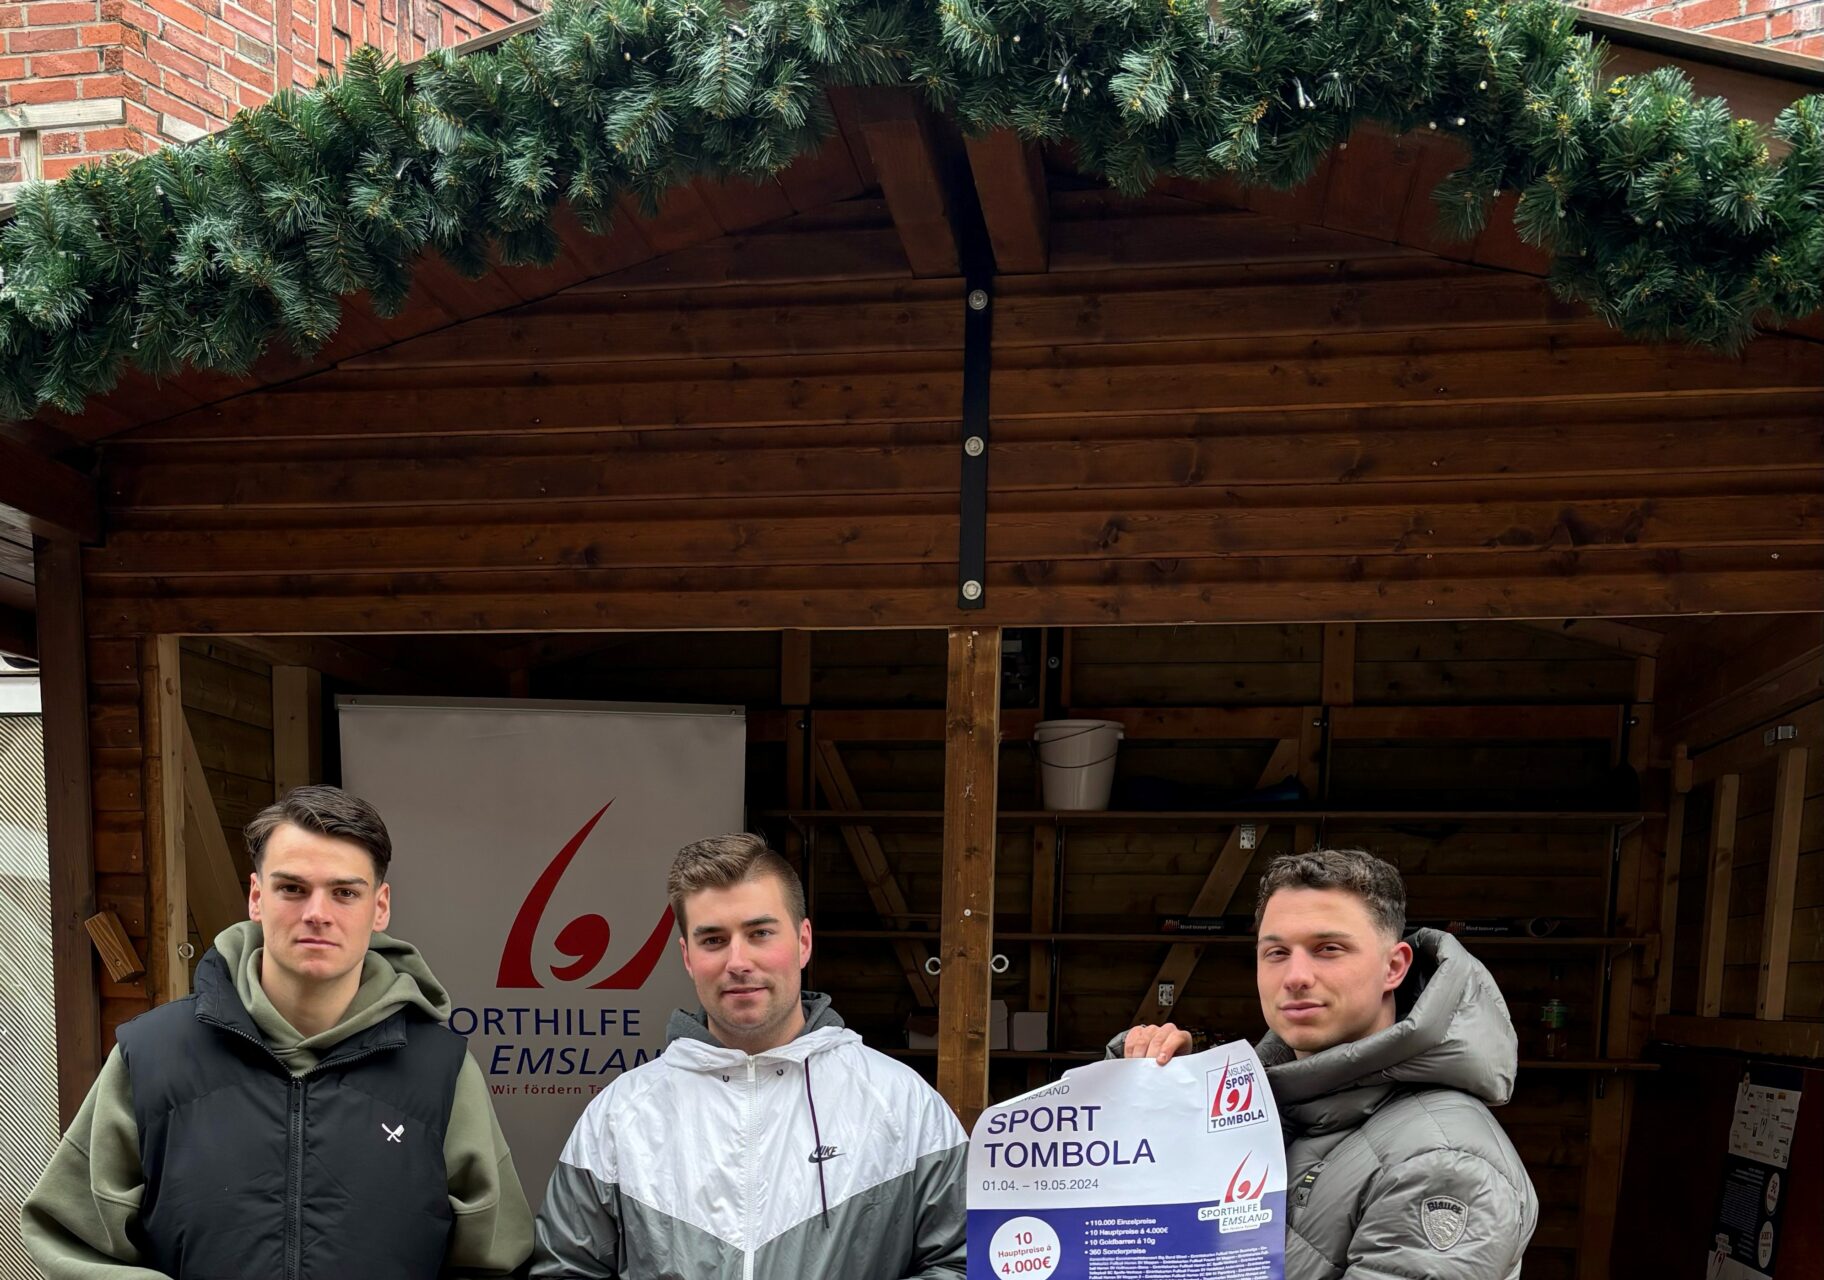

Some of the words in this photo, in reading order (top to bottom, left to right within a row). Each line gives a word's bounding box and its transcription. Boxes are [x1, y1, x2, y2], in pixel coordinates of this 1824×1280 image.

[448, 1007, 641, 1036] ORTHILFE
[489, 1045, 661, 1075] EMSLAN
[1225, 1072, 1255, 1089] SPORT
[491, 1084, 517, 1095] Wir
[524, 1083, 581, 1095] fördern
[588, 1084, 603, 1095] Ta
[987, 1105, 1102, 1135] SPORT
[1211, 1109, 1265, 1129] TOMBOLA
[984, 1138, 1156, 1168] TOMBOLA
[982, 1180, 1019, 1191] 01.04.
[1034, 1178, 1099, 1191] 19.05.2024
[1200, 1203, 1258, 1219] SPORTHILFE
[1426, 1201, 1464, 1215] Blauer
[1222, 1212, 1270, 1226] EMSLAND
[1014, 1231, 1032, 1245] 10
[1099, 1228, 1139, 1236] Hauptpreise
[997, 1246, 1044, 1258] Hauptpreise
[1001, 1256, 1052, 1275] 4.000€
